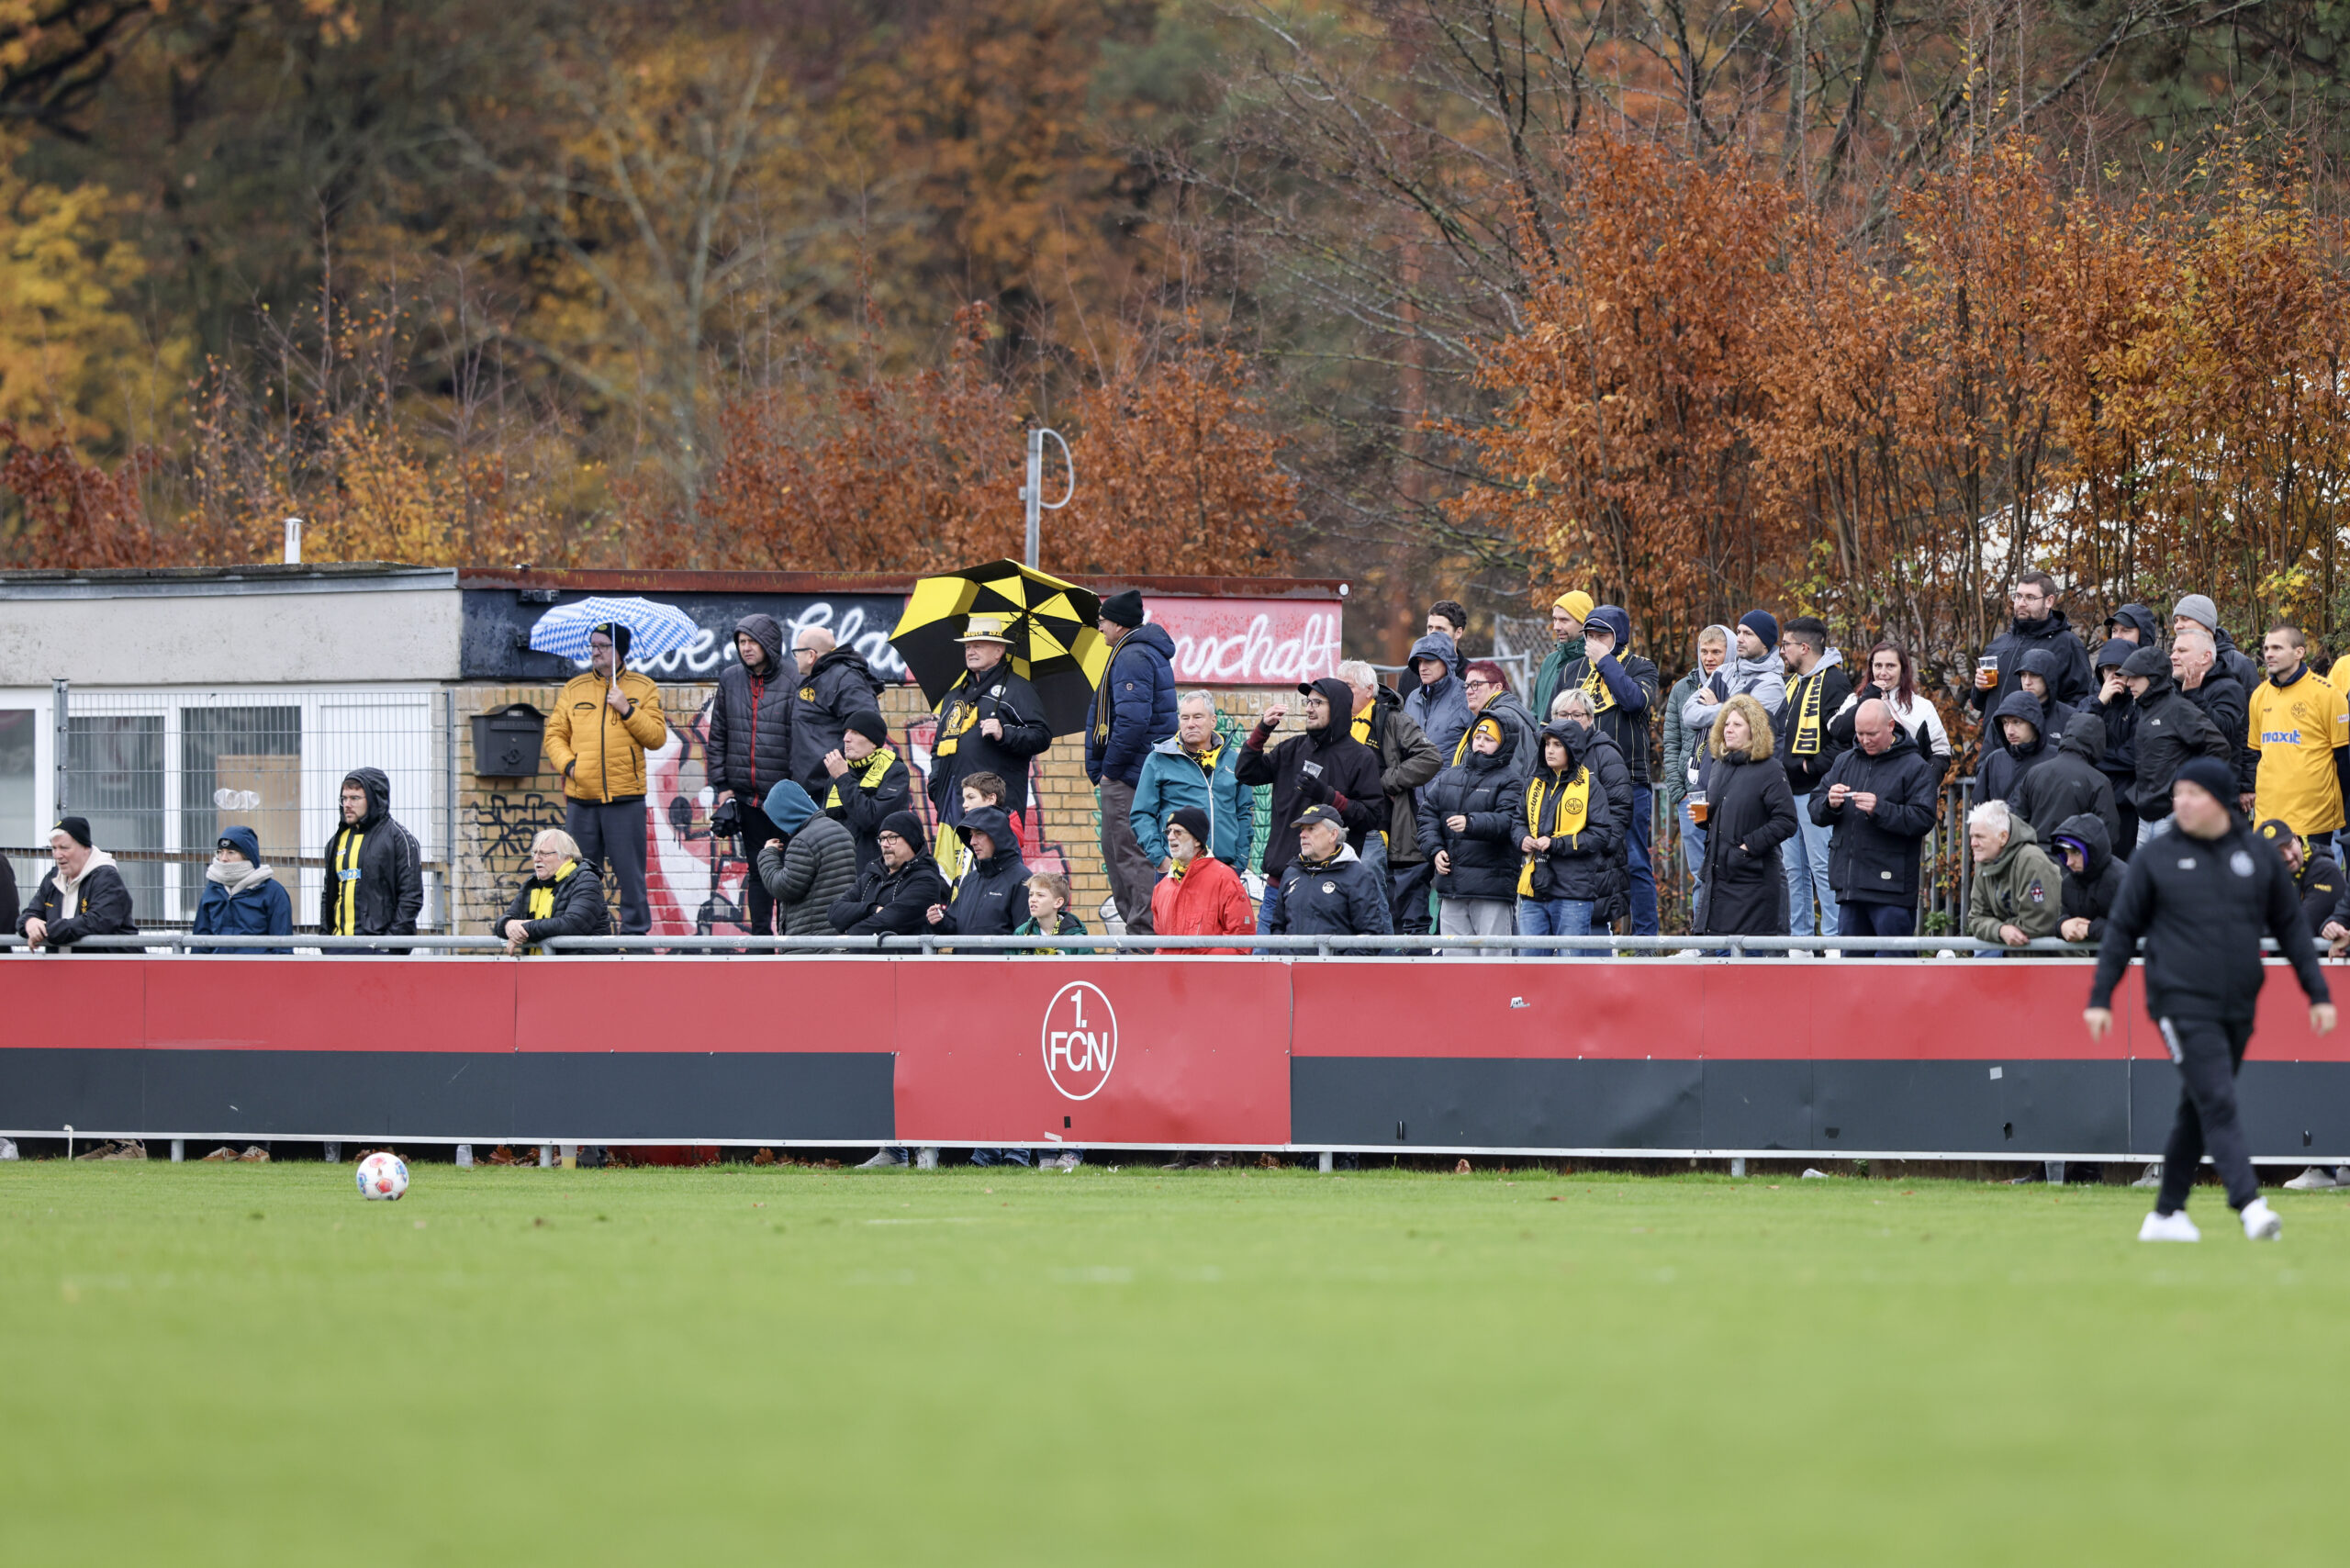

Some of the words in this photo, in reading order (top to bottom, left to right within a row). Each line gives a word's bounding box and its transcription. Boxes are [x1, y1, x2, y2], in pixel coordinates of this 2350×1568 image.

[1169, 612, 1342, 683] nschaft
[2261, 729, 2301, 745] maxit
[1070, 989, 1088, 1028] 1.
[1050, 1030, 1108, 1072] FCN
